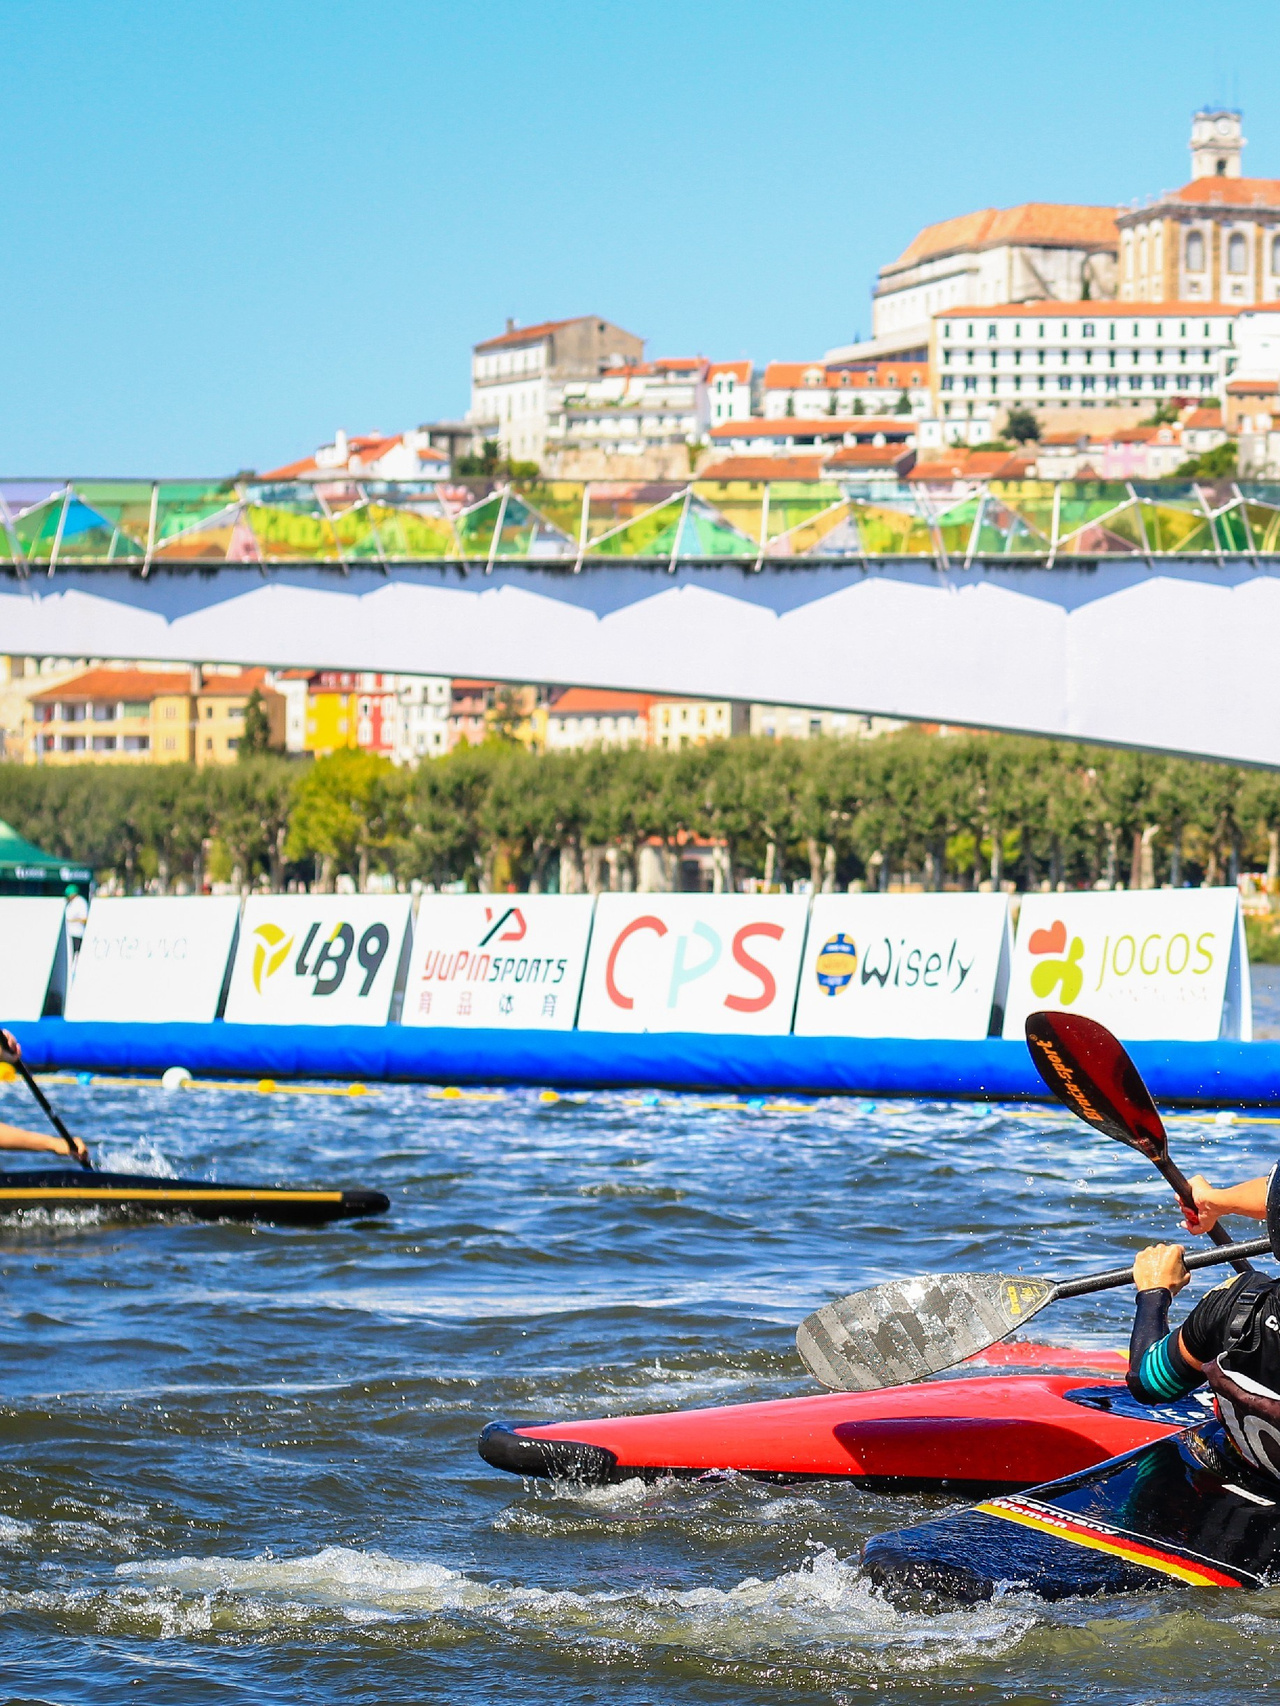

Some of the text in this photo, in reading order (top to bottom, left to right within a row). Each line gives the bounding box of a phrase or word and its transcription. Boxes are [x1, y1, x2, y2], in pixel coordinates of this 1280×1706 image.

[606, 915, 784, 1013] CPS
[861, 937, 975, 994] Wisely
[1096, 932, 1215, 991] JOGOS
[992, 1500, 1068, 1529] Women
[1006, 1497, 1119, 1535] Germany
